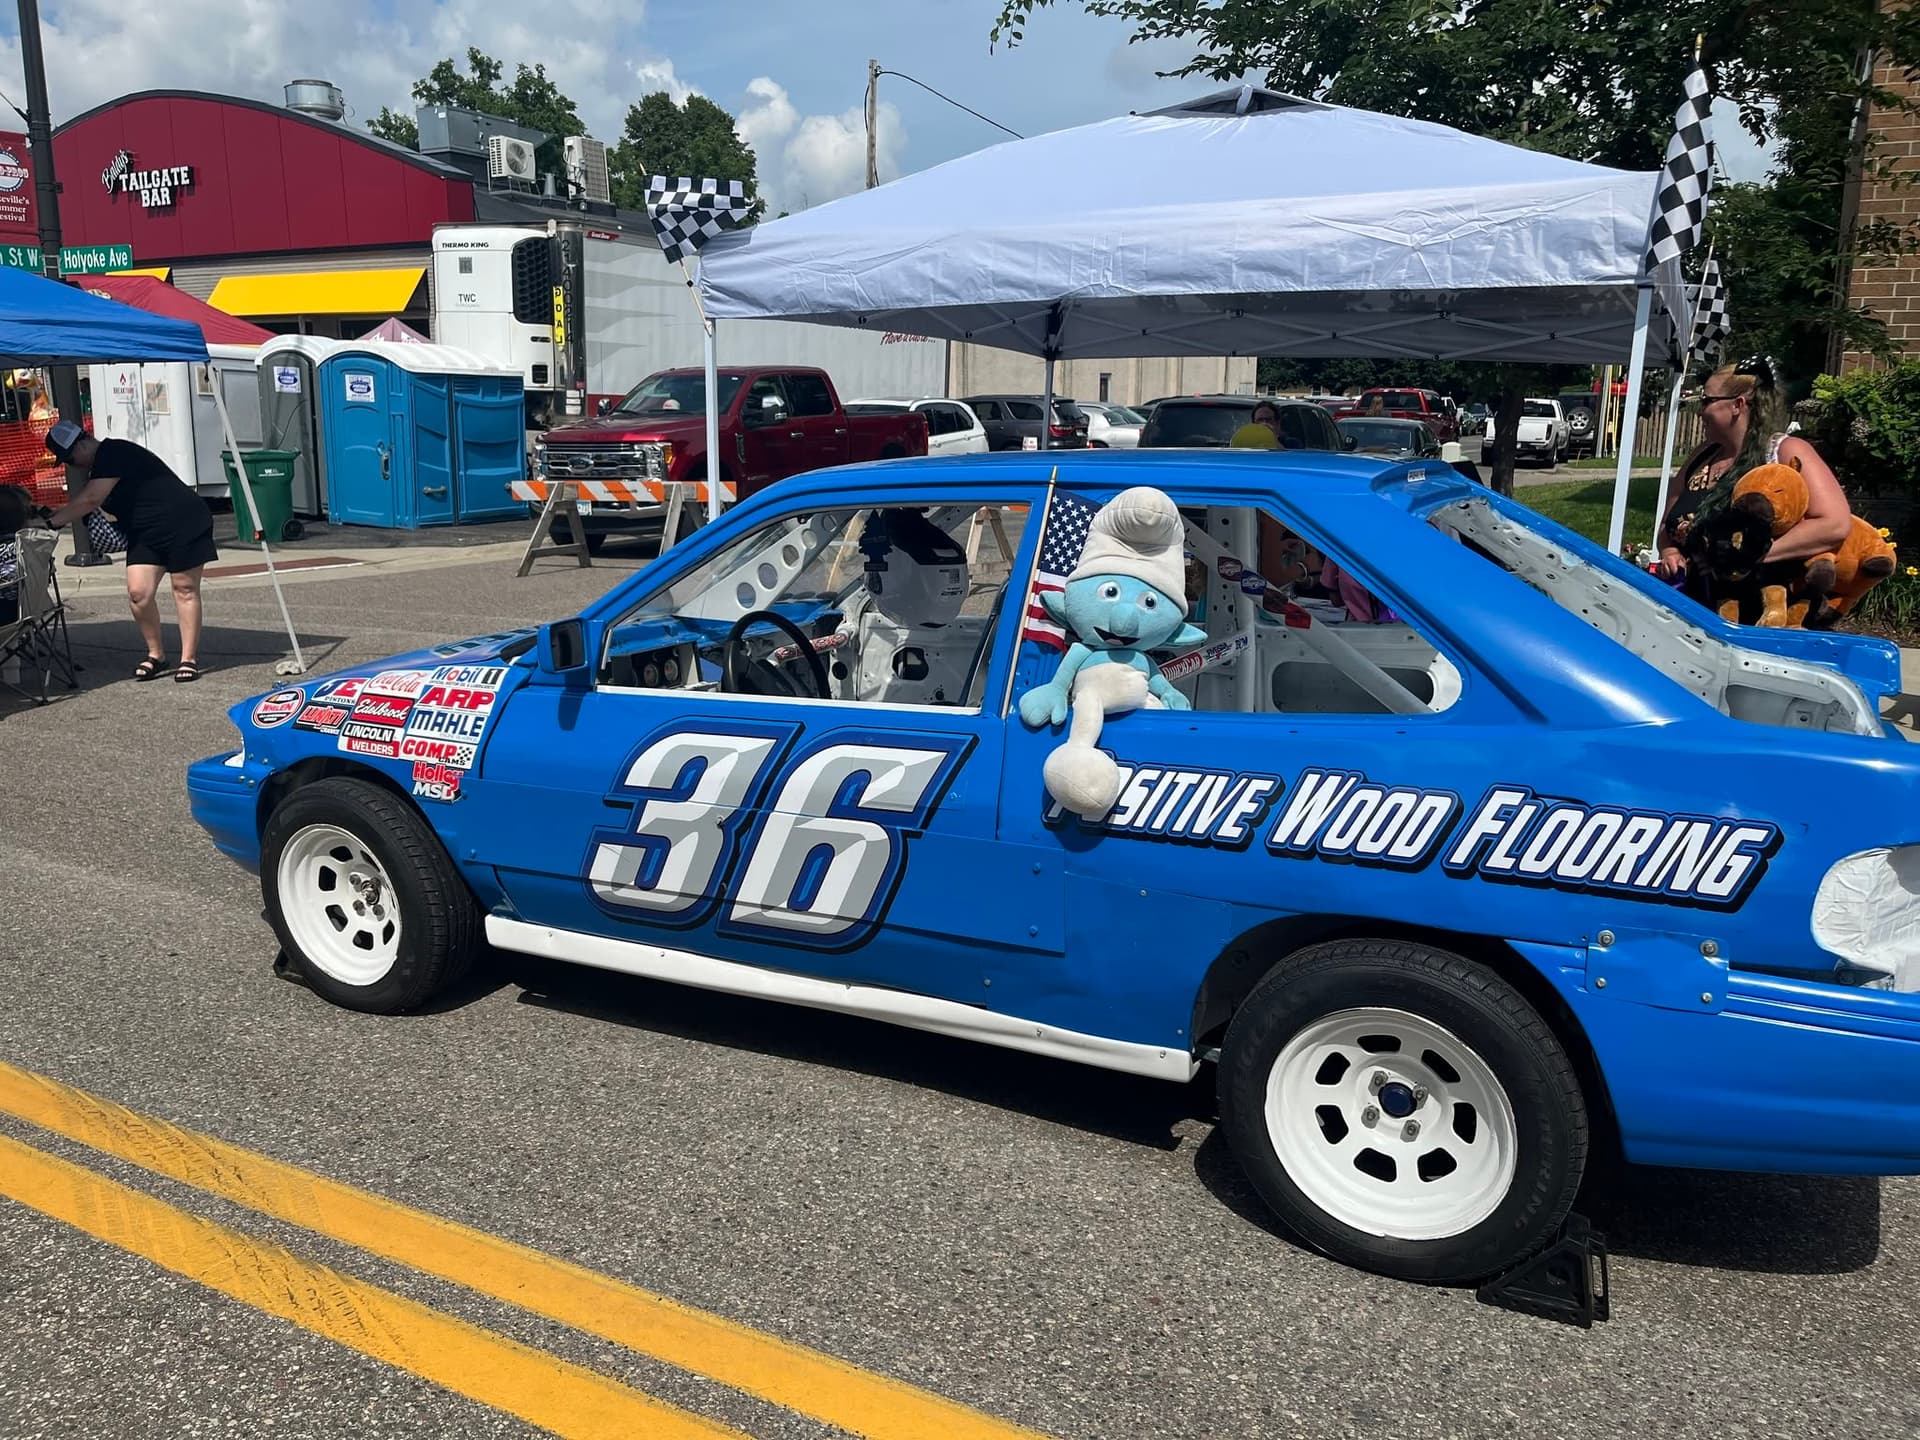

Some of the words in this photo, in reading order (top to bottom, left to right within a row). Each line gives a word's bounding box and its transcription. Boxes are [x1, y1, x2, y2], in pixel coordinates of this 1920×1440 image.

[119, 165, 190, 192] TAILGATE
[141, 187, 171, 207] BAR
[9, 247, 22, 266] St
[27, 248, 38, 266] W
[64, 249, 105, 273] Holyoke
[109, 248, 128, 266] Ave
[458, 293, 476, 303] TWC
[431, 667, 483, 683] Mobil
[483, 668, 504, 685] 1
[313, 679, 367, 698] JE
[419, 687, 495, 710] ARP
[354, 698, 411, 721] Edelbrock
[343, 723, 394, 742] LINCOLN
[410, 709, 485, 738] MAHLE
[351, 739, 394, 756] WELDERS
[402, 738, 458, 759] COMP
[438, 756, 466, 766] CAMS
[584, 727, 955, 940] 36
[1047, 766, 1275, 839] SITIVE
[1271, 772, 1453, 858] WOOD
[1449, 789, 1769, 897] FLOORING
